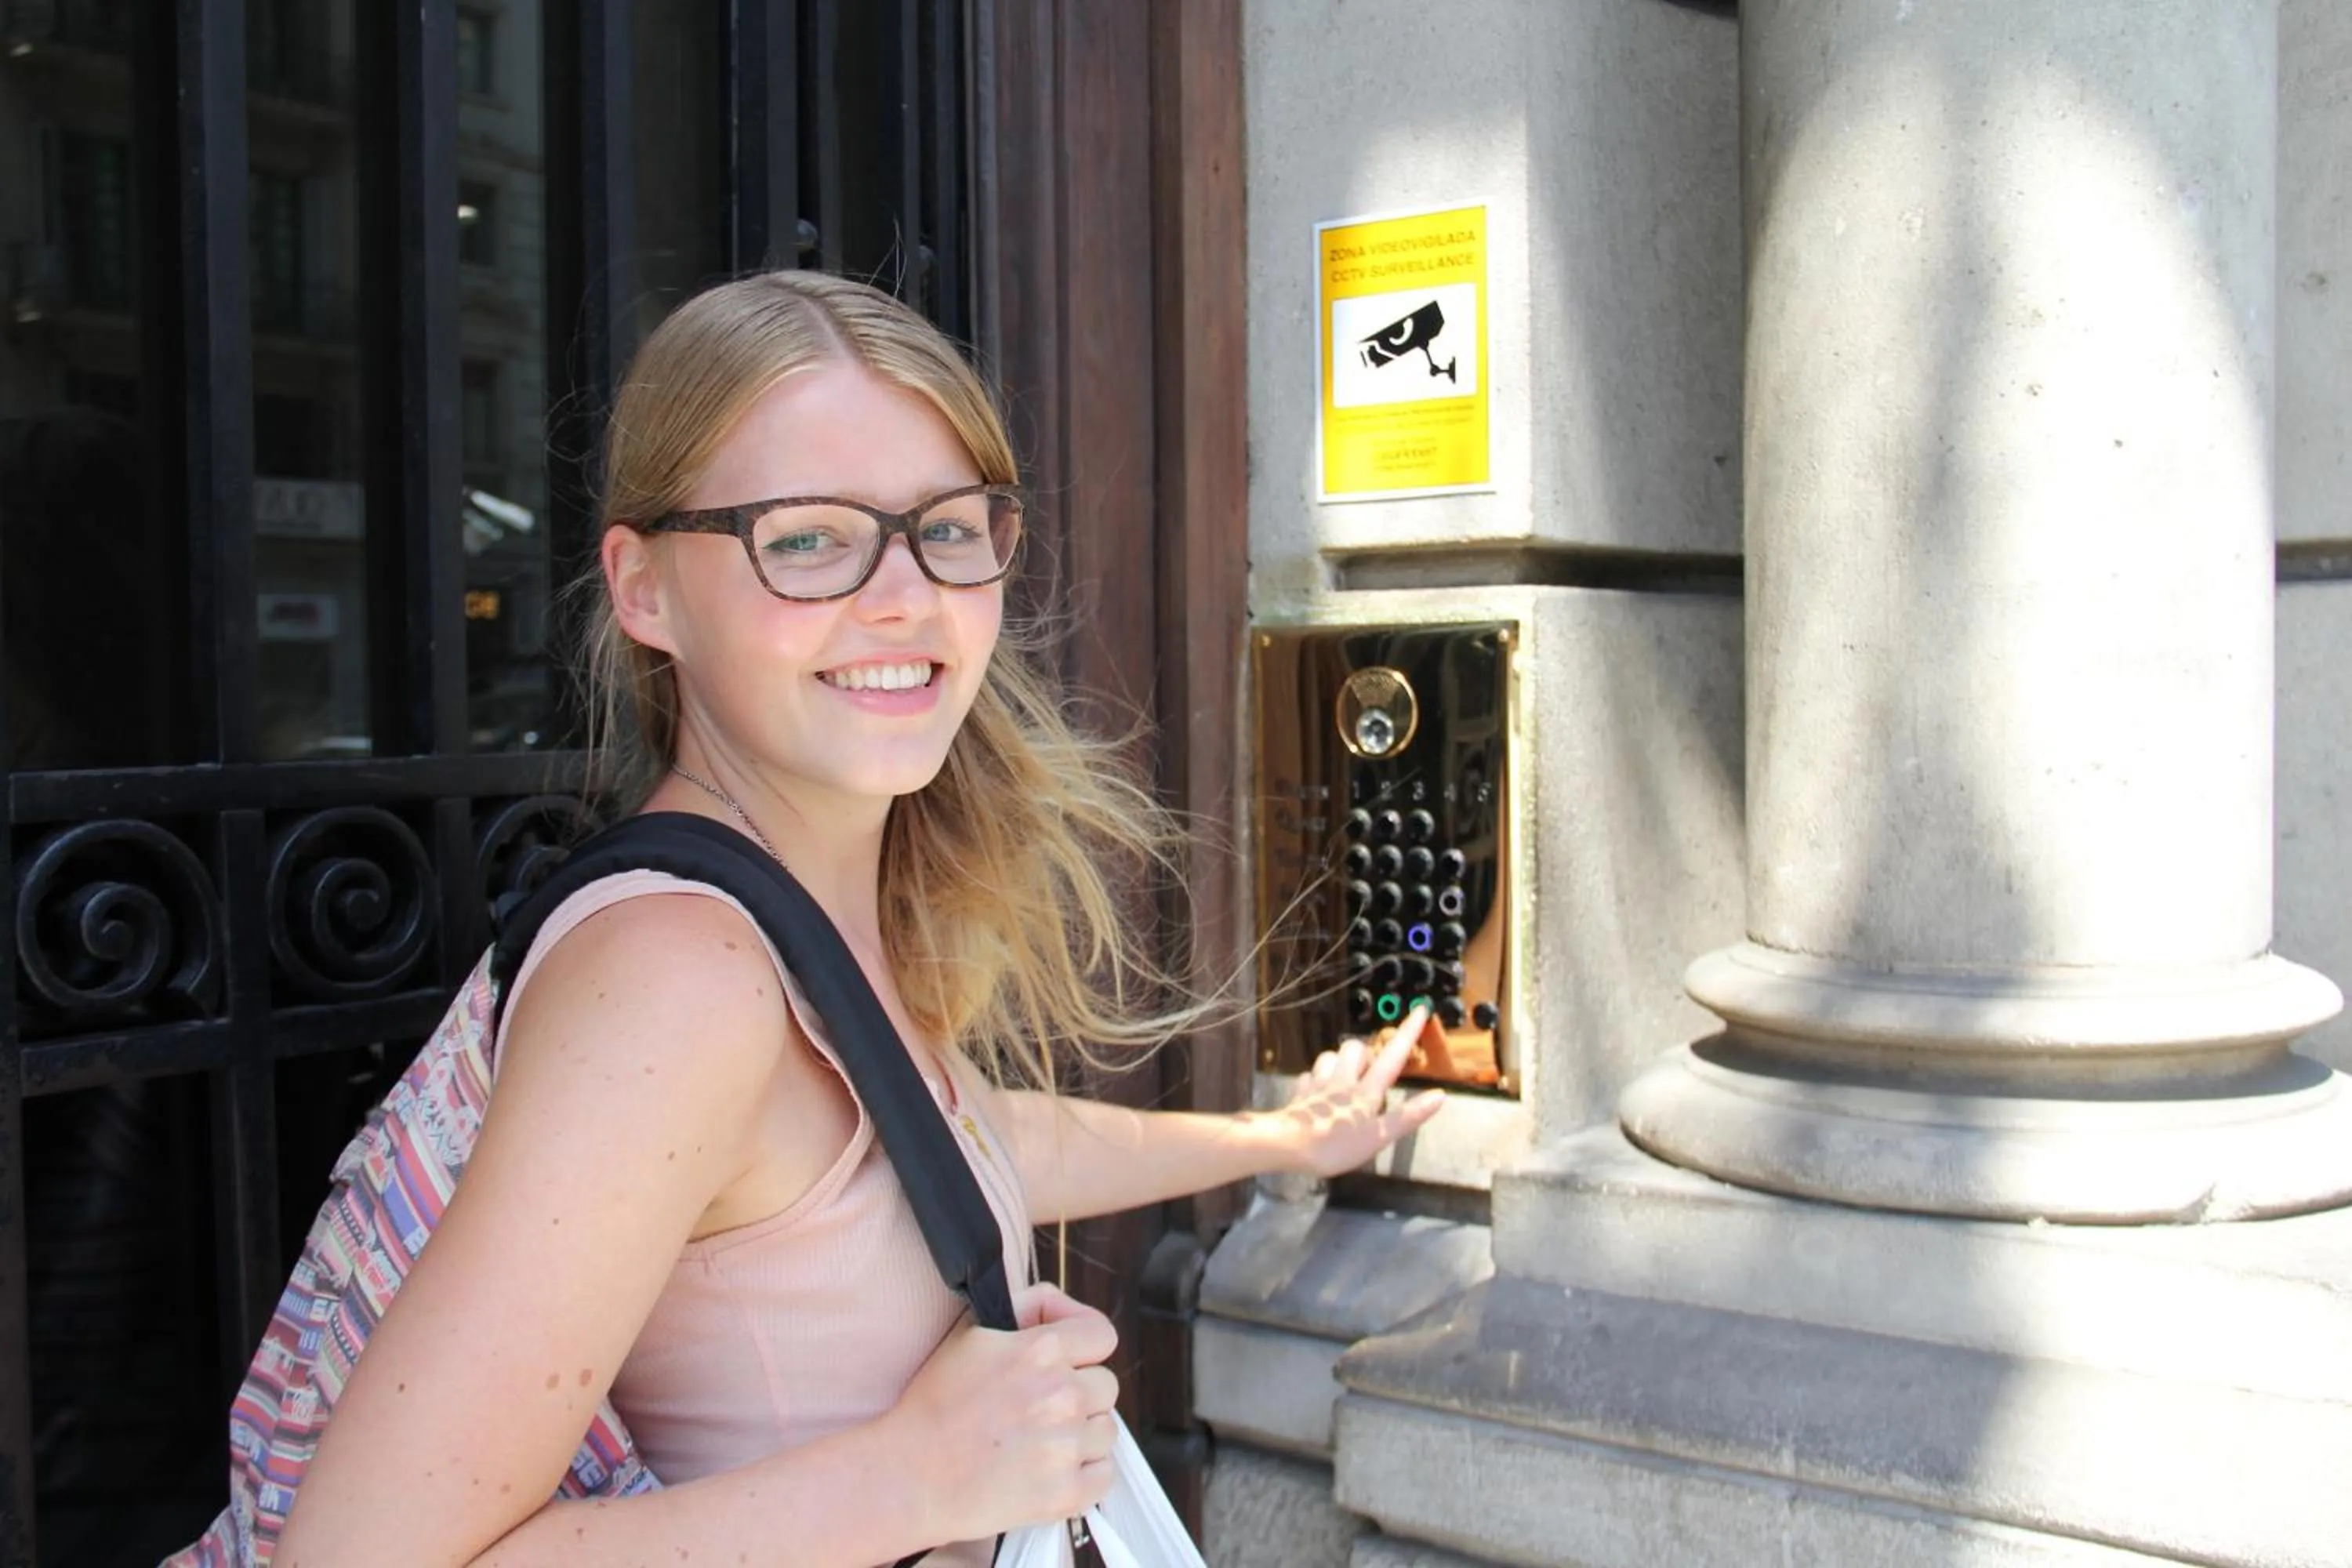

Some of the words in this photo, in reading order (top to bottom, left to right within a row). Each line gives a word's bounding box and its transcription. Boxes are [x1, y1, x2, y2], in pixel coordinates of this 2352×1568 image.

[1329, 245, 1366, 263] ZONA
[1368, 230, 1476, 256] VIDEOVIGILADA
[1330, 267, 1367, 283] CCTV
[1369, 252, 1475, 278] SURVEILLANCE
